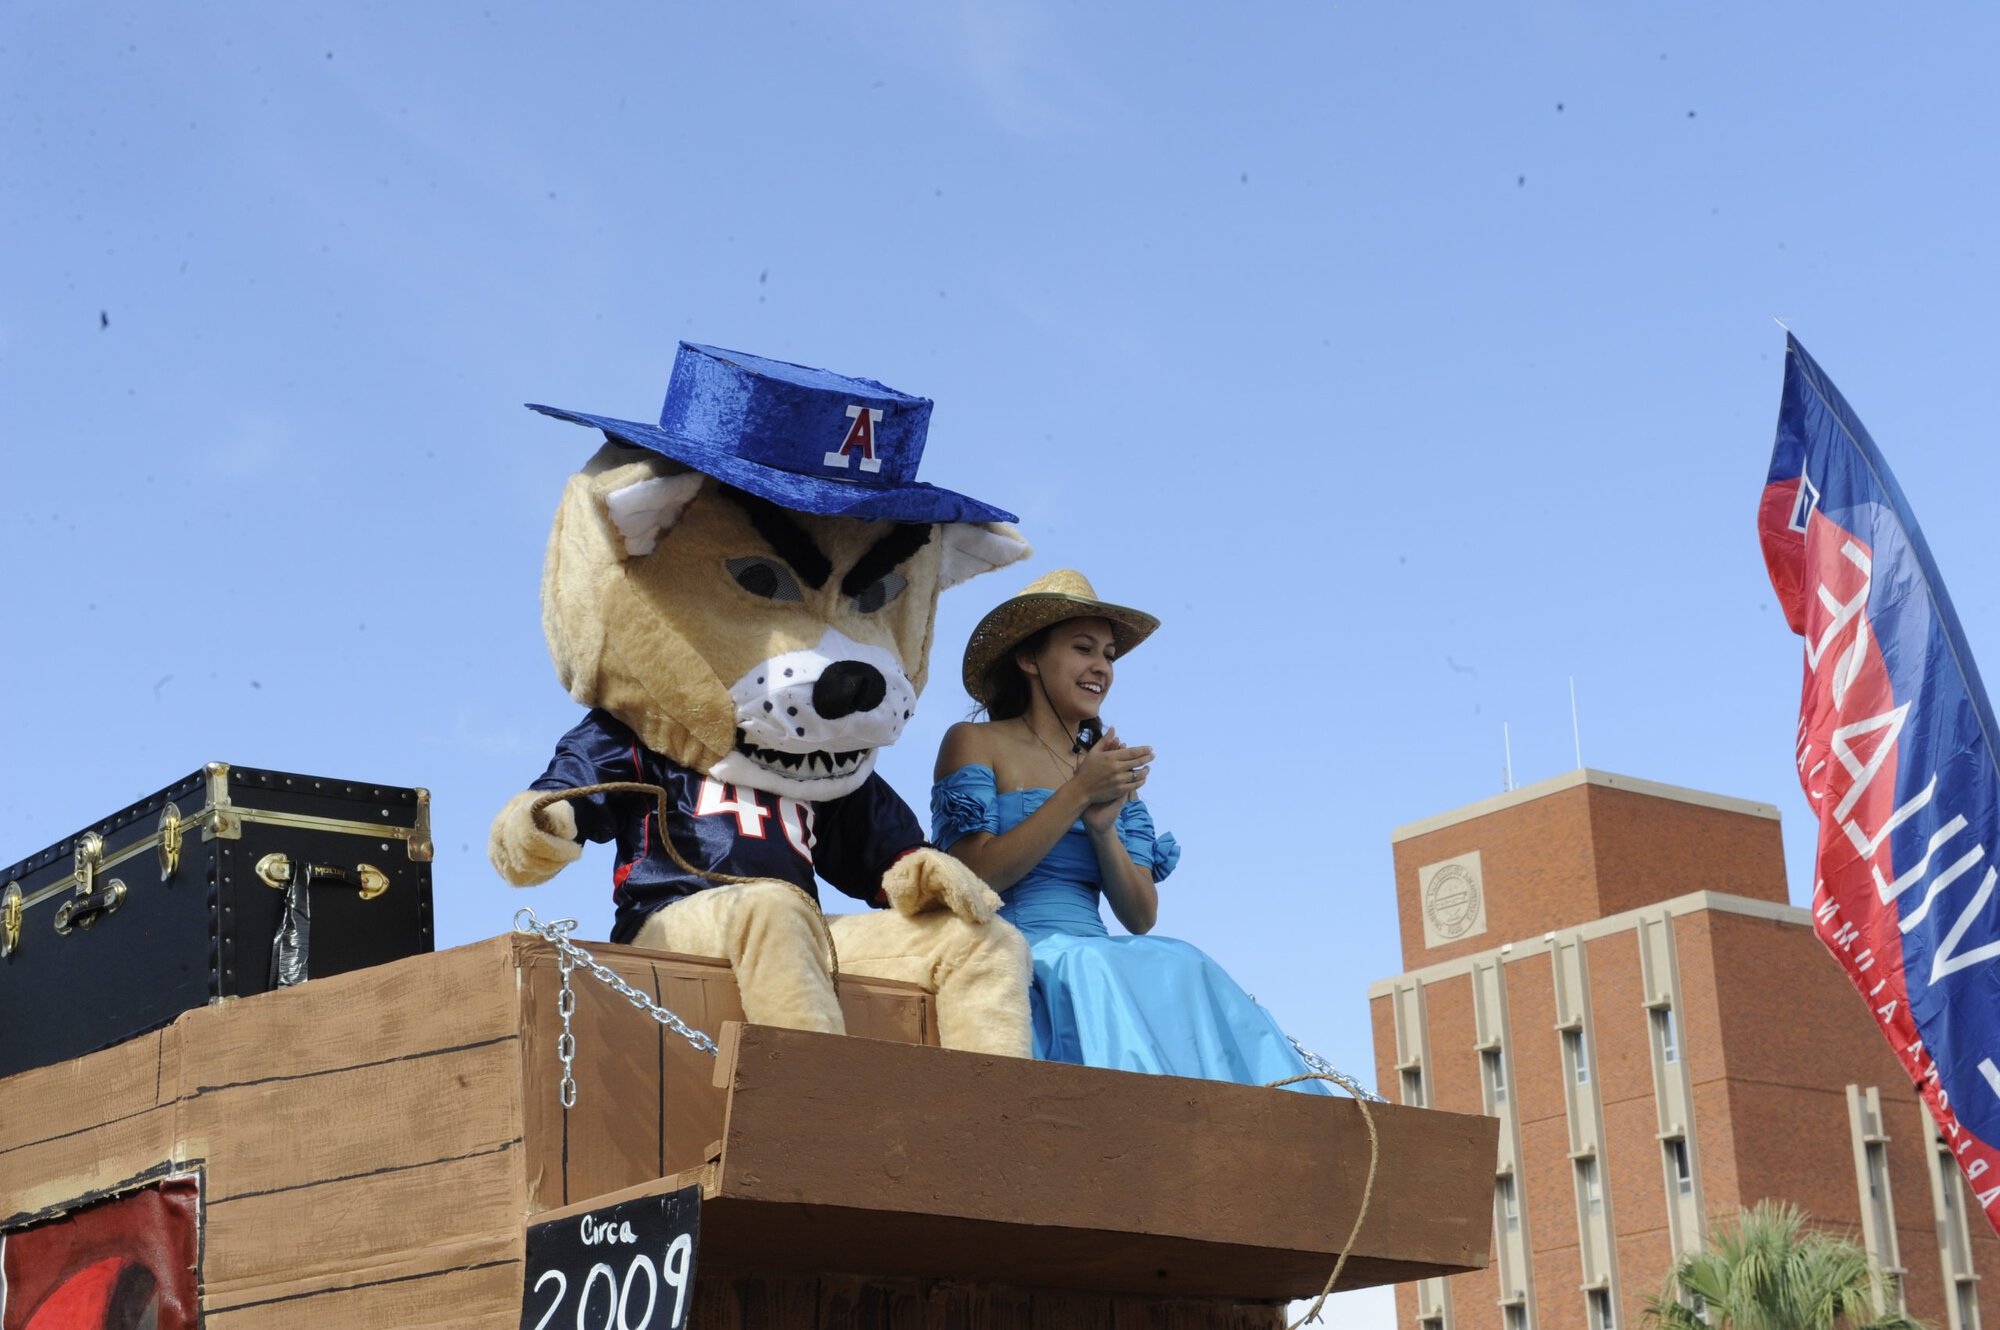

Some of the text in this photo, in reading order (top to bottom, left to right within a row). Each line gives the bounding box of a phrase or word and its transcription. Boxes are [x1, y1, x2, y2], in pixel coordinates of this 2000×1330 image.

[823, 405, 883, 473] A
[693, 775, 817, 866] 40
[580, 1214, 639, 1246] Circa
[533, 1232, 692, 1330] 2009
